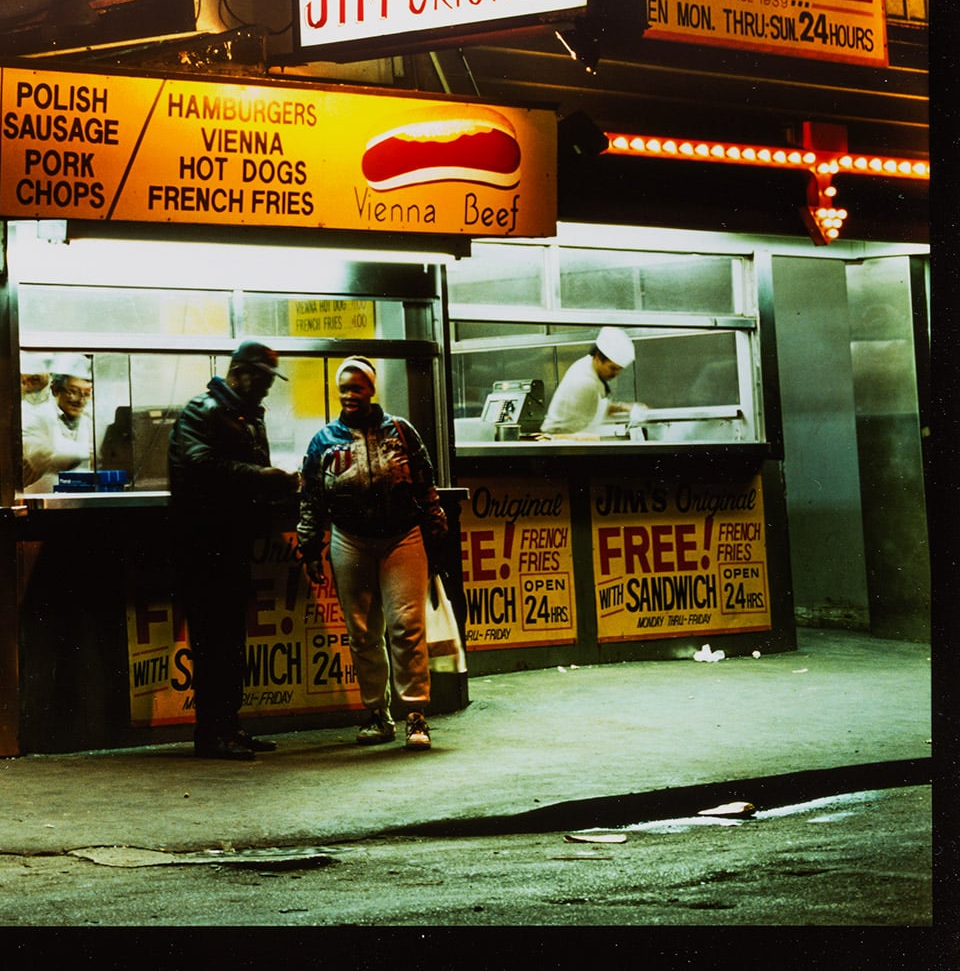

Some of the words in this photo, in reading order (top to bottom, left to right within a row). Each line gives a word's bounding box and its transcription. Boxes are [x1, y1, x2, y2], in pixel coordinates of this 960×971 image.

[677, 1, 716, 31] MON.
[799, 11, 828, 44] 24
[829, 23, 874, 52] HOURS
[17, 82, 108, 113] POLISH
[167, 93, 317, 126] HAMBURGERS
[3, 112, 119, 145] SAUSAGE
[200, 127, 284, 156] VIENNA
[25, 149, 94, 178] PORK
[179, 156, 228, 181] HOT
[242, 159, 307, 185] DOGS
[16, 179, 105, 209] CHOPS
[148, 185, 243, 213] FRENCH
[251, 189, 314, 216] FRIES
[354, 186, 436, 224] Vienna
[464, 192, 520, 232] Beef
[296, 317, 320, 332] FRENCH
[324, 315, 342, 330] FRIES
[472, 487, 563, 524] Original
[676, 485, 756, 517] Original
[520, 528, 568, 549] FRENCH
[598, 516, 714, 575] FREE!
[718, 523, 761, 542] FRENCH
[519, 551, 560, 572] FRIES
[717, 544, 752, 562] FRIES
[524, 579, 565, 592] OPEN
[723, 568, 759, 579] OPEN
[599, 583, 624, 610] WITH
[626, 574, 717, 612] SANDWICH
[724, 582, 746, 609] 24
[525, 595, 550, 624] 24
[637, 616, 664, 628] MONDAY
[312, 633, 350, 647] OPE
[133, 655, 169, 688] WITH
[312, 651, 343, 685] 24
